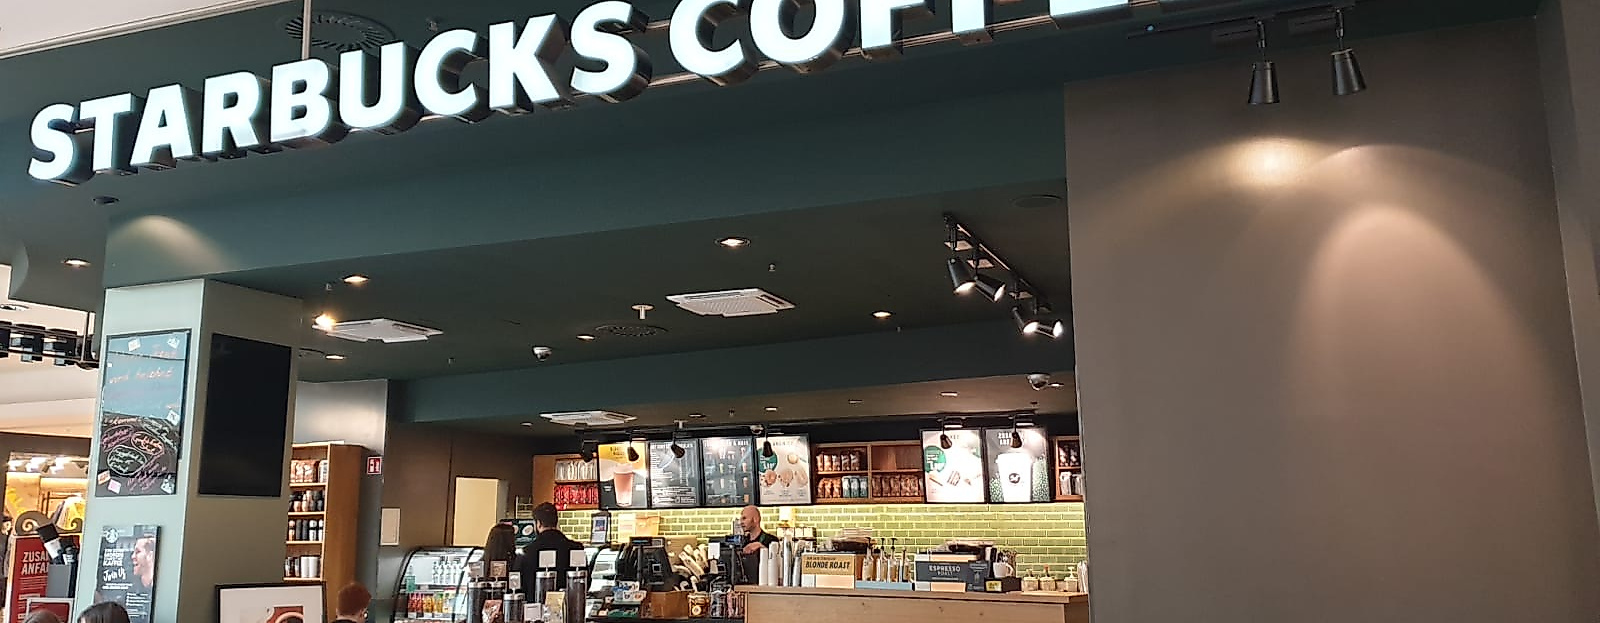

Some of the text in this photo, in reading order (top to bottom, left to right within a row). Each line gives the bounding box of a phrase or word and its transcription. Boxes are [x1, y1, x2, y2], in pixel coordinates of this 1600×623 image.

[28, 1, 638, 181] STARBUCKS
[805, 560, 850, 570] BLONDE ROAST
